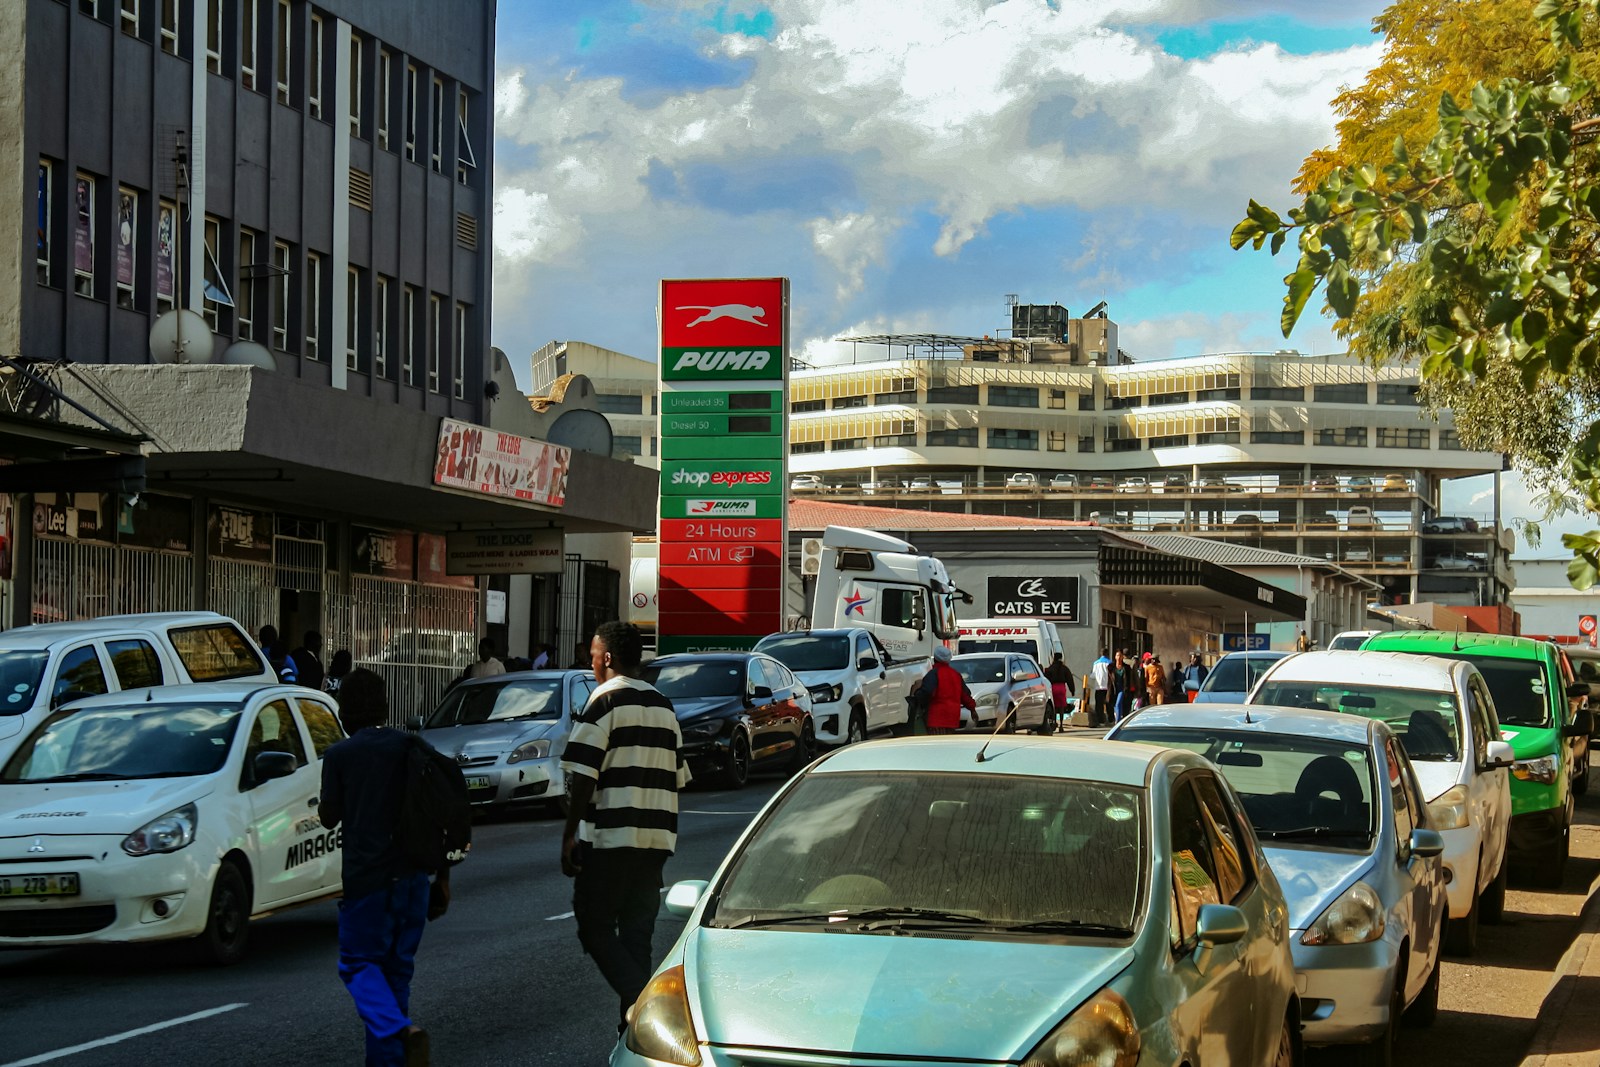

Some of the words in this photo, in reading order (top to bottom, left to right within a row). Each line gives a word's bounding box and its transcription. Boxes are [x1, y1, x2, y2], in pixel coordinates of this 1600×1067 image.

[672, 351, 771, 371] PUMA
[671, 398, 710, 407] Unleaded
[713, 398, 724, 407] 95
[671, 421, 696, 430] Diesel
[698, 421, 709, 429] 50
[671, 468, 709, 488] shop
[711, 470, 772, 488] express
[712, 501, 750, 509] PUMA
[47, 508, 65, 532] Lee
[219, 511, 255, 542] EDGE
[685, 524, 704, 538] 24
[710, 523, 756, 538] Hours
[475, 535, 497, 546] THE
[501, 534, 533, 545] EDGE
[450, 550, 485, 559] EXCLUSIVE
[687, 547, 721, 561] ATM
[994, 601, 1034, 614] CATS
[1041, 601, 1071, 614] EYE
[885, 643, 908, 651] STAR
[1236, 636, 1265, 649] PEP
[14, 811, 89, 820] MIRAGE
[285, 827, 343, 871] MIRAGE
[23, 877, 47, 893] 278
